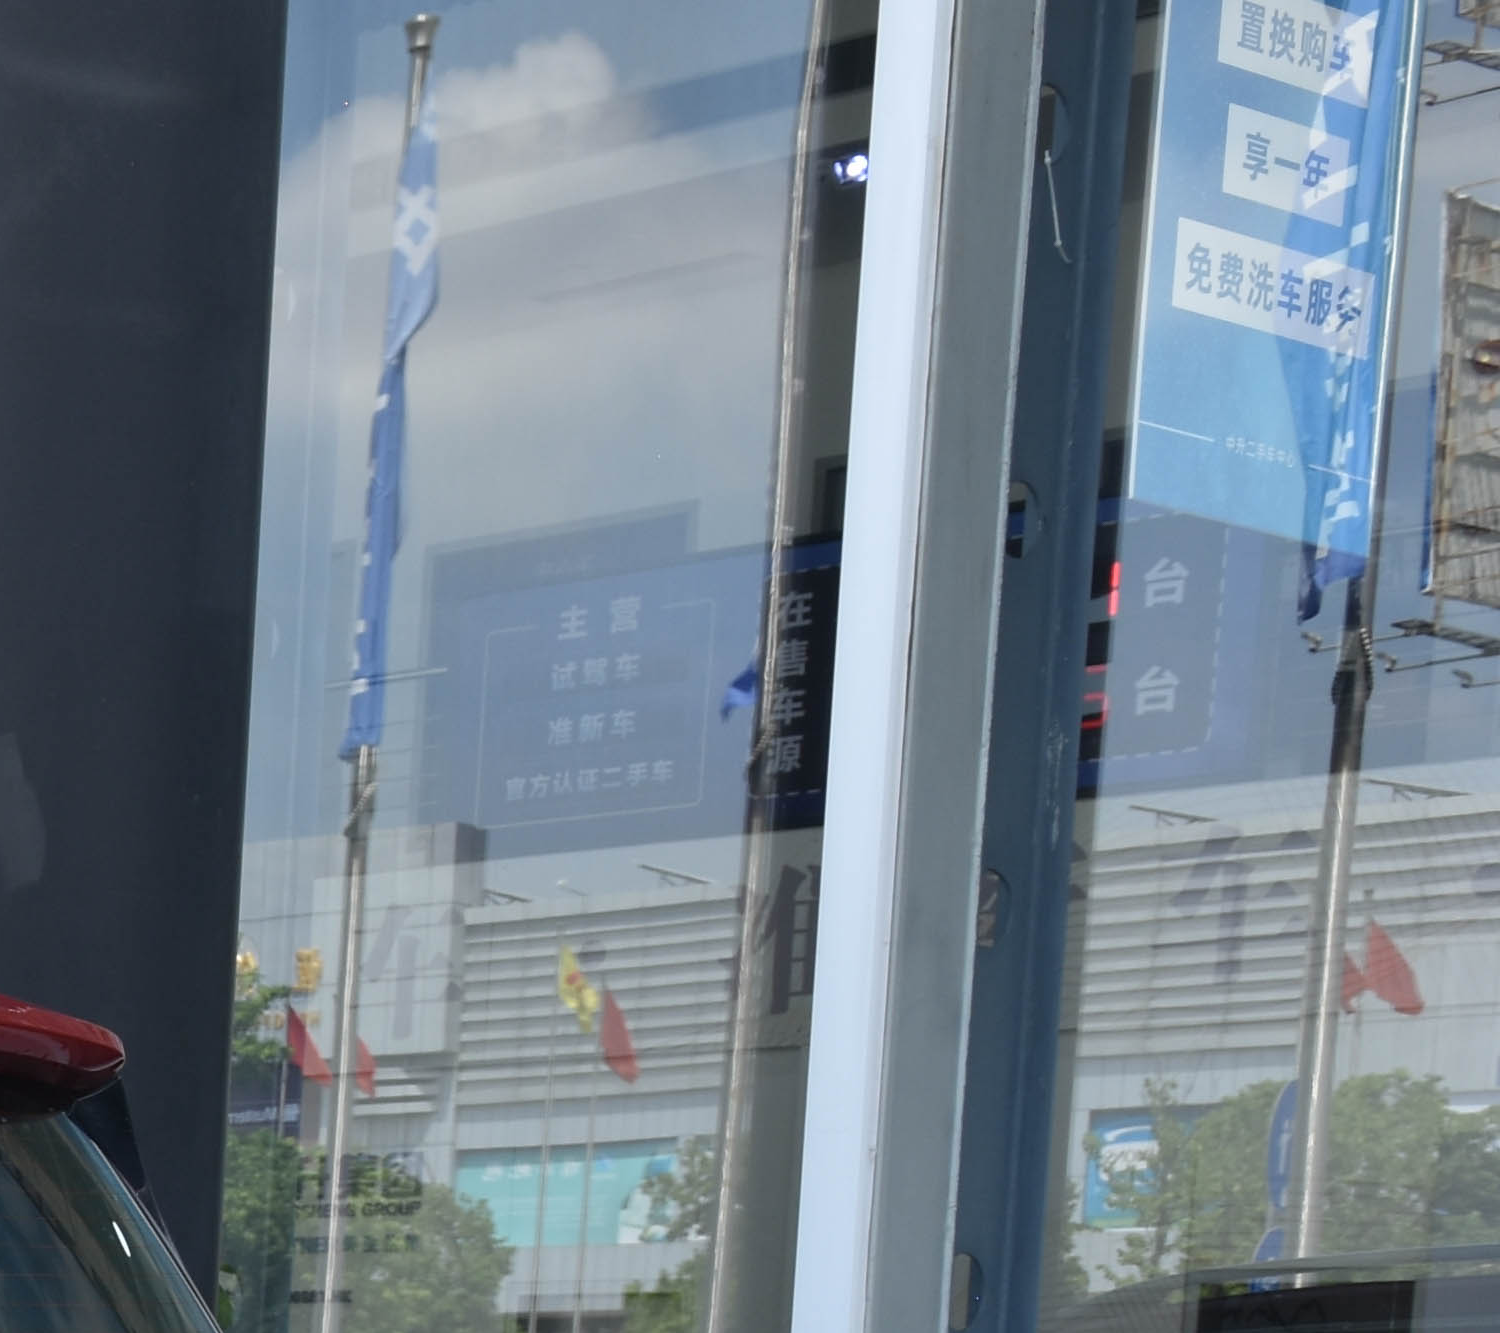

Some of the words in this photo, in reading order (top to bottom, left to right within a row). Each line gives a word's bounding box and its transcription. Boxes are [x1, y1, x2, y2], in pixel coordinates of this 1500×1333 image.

[1242, 131, 1330, 198] 享一年
[1184, 241, 1362, 334] 免费洗车服务
